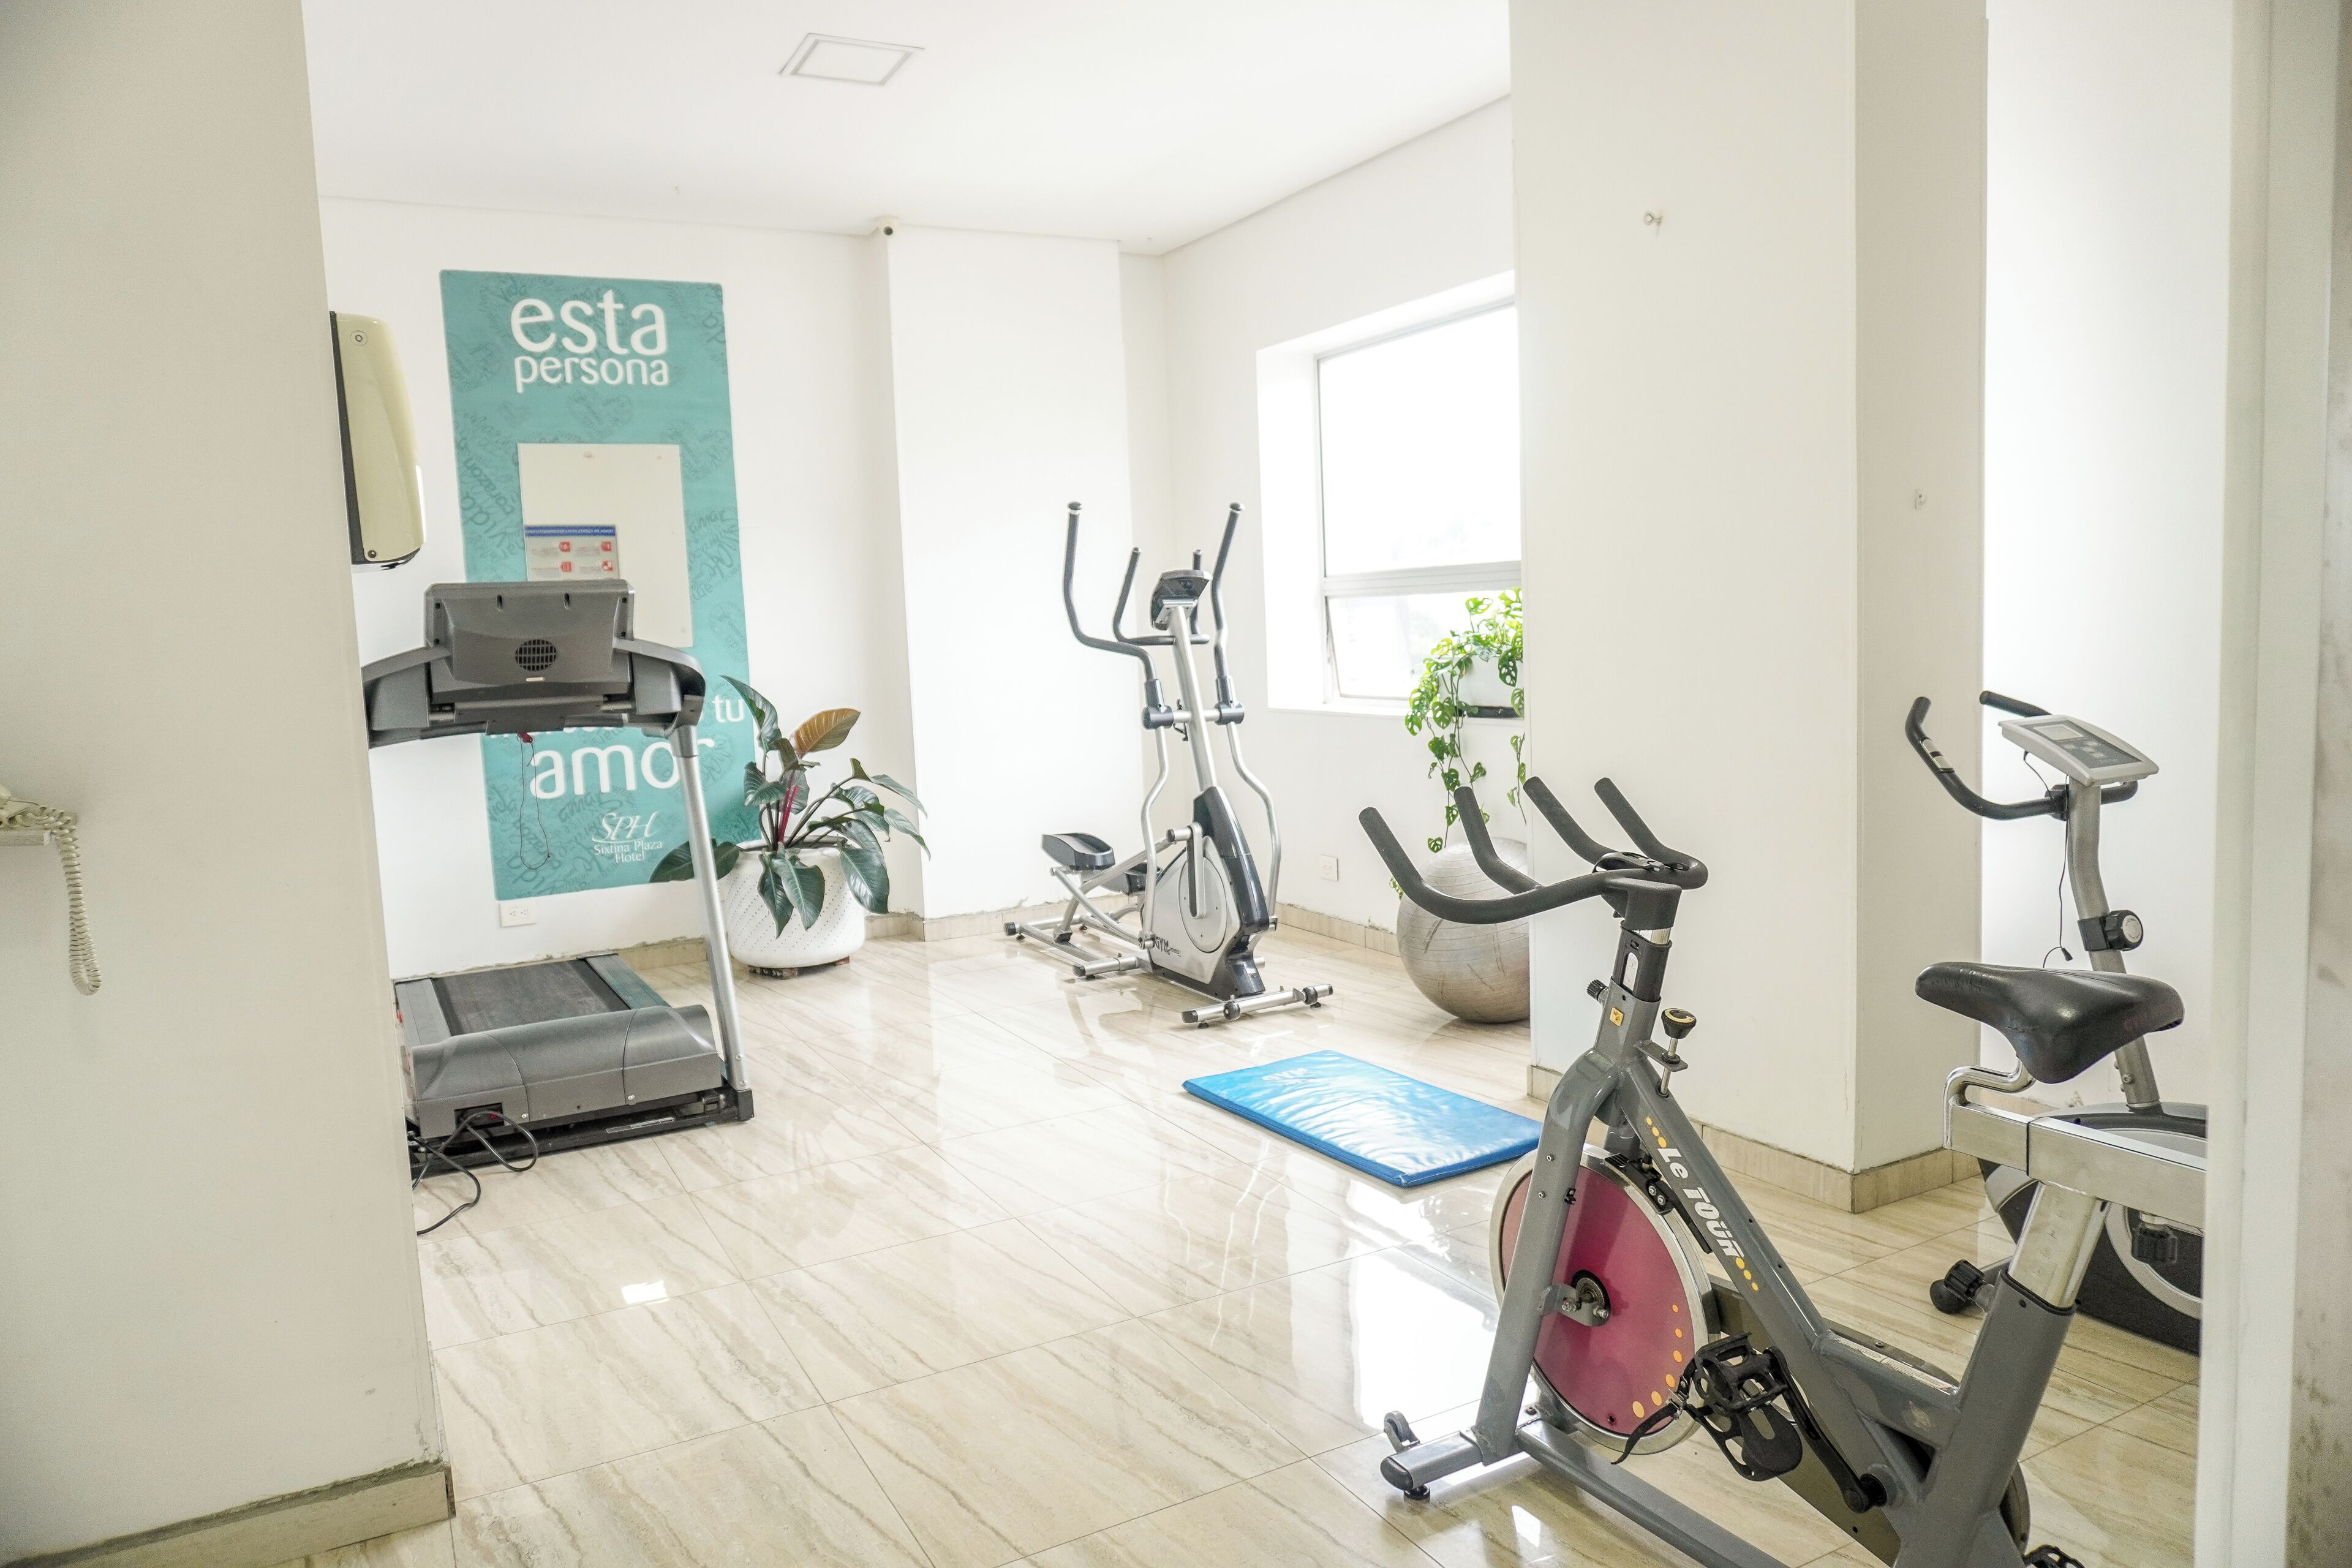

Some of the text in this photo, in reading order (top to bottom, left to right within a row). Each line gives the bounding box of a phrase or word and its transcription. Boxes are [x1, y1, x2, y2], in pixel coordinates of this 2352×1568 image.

[511, 290, 666, 355] esta
[514, 356, 669, 393] persona
[712, 695, 744, 723] tu
[592, 810, 661, 843] SPH
[594, 840, 662, 856] Sixtina Plaza
[616, 850, 645, 863] Hotel
[1683, 1187, 1744, 1258] TOUR
